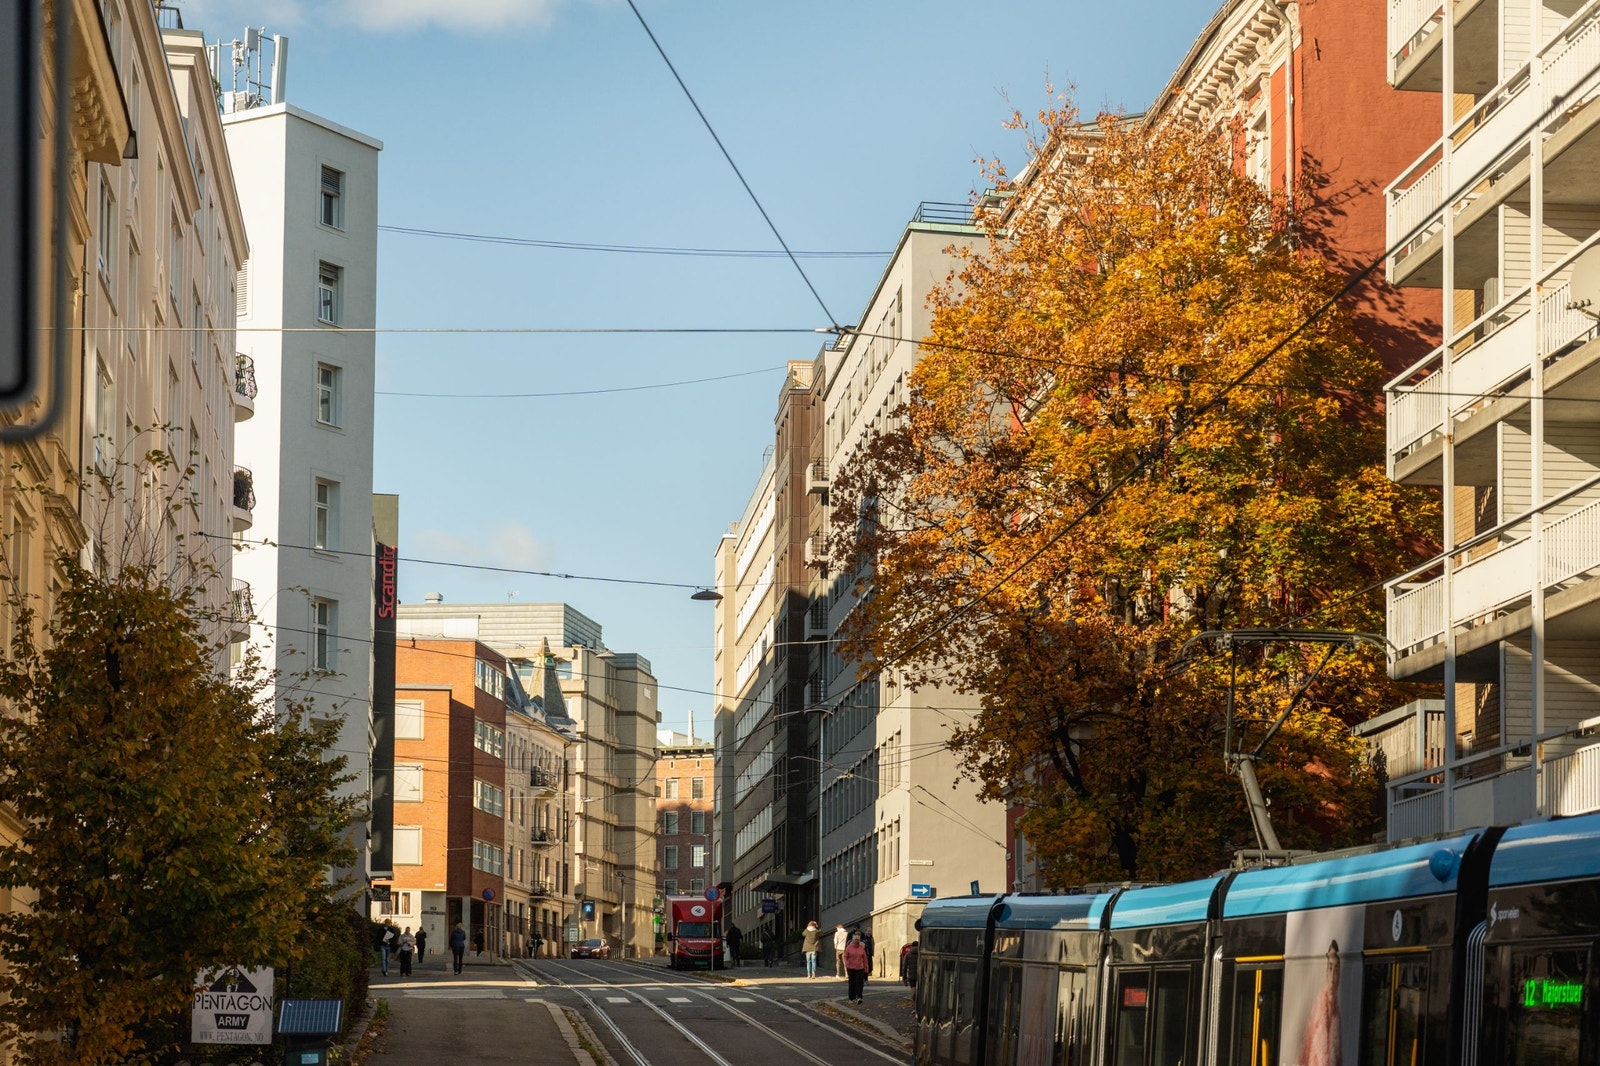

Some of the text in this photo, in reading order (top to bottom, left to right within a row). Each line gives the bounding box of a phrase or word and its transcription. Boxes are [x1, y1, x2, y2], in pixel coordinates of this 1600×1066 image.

[378, 546, 397, 618] Scandic
[192, 994, 272, 1011] PENTAGON
[1525, 979, 1536, 1006] 12
[218, 1016, 247, 1026] ARMY
